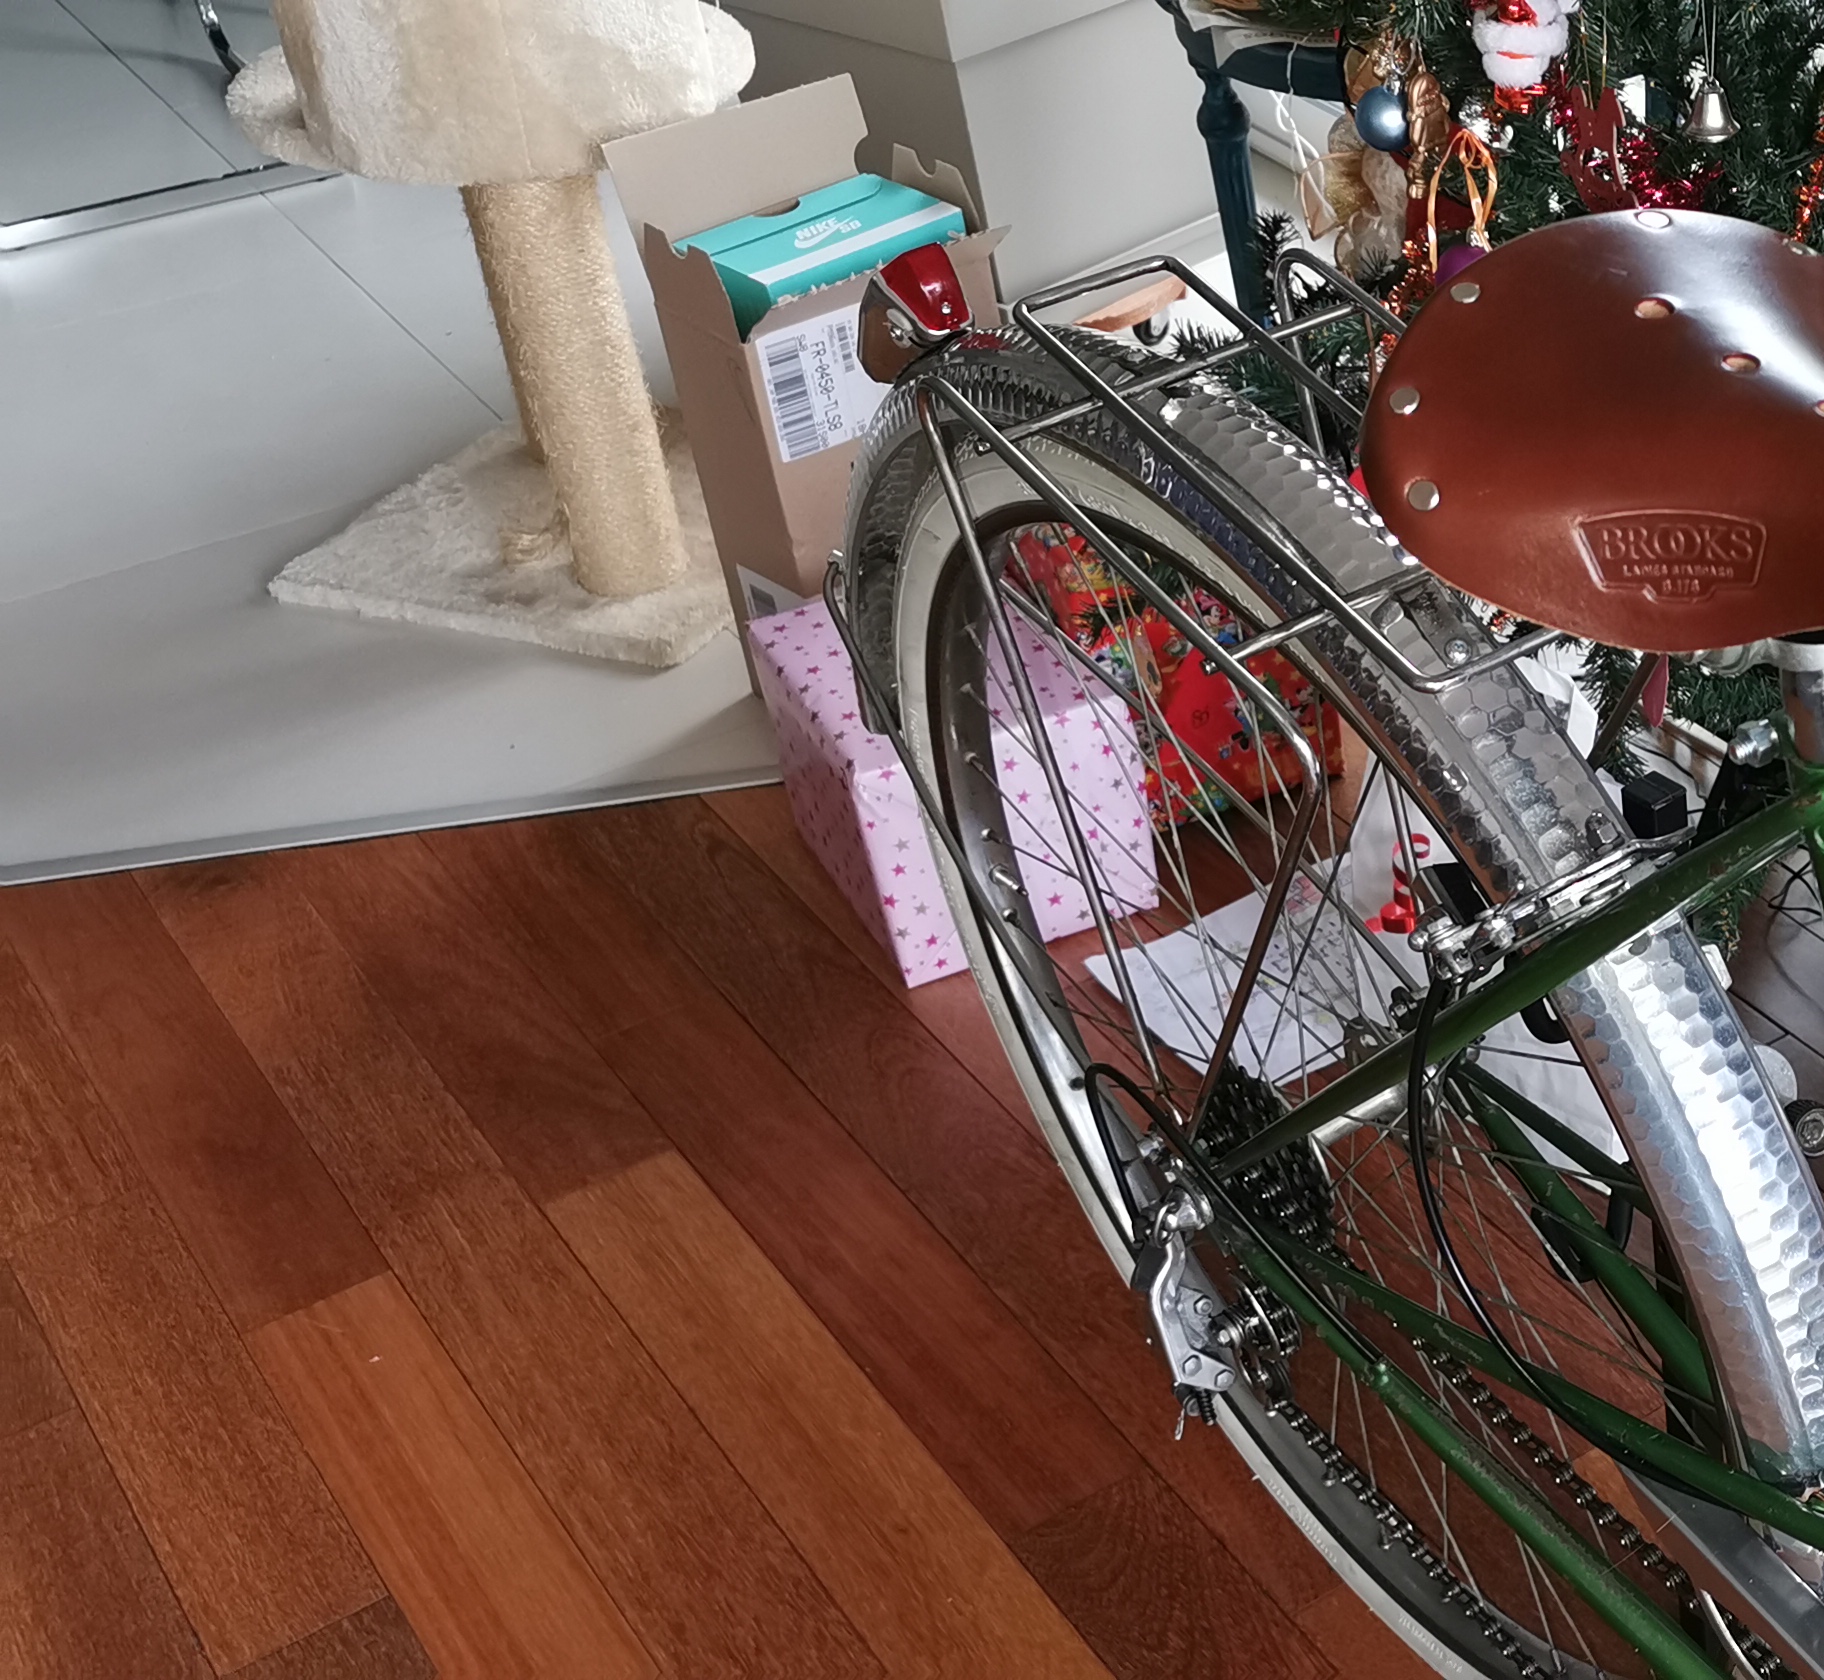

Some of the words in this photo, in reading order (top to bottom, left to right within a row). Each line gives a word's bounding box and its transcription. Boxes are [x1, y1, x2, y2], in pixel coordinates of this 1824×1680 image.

[795, 217, 838, 240] NIKE
[839, 220, 861, 234] SB
[810, 341, 843, 431] FR-0450-TLS8
[1599, 523, 1753, 562] BROOKS
